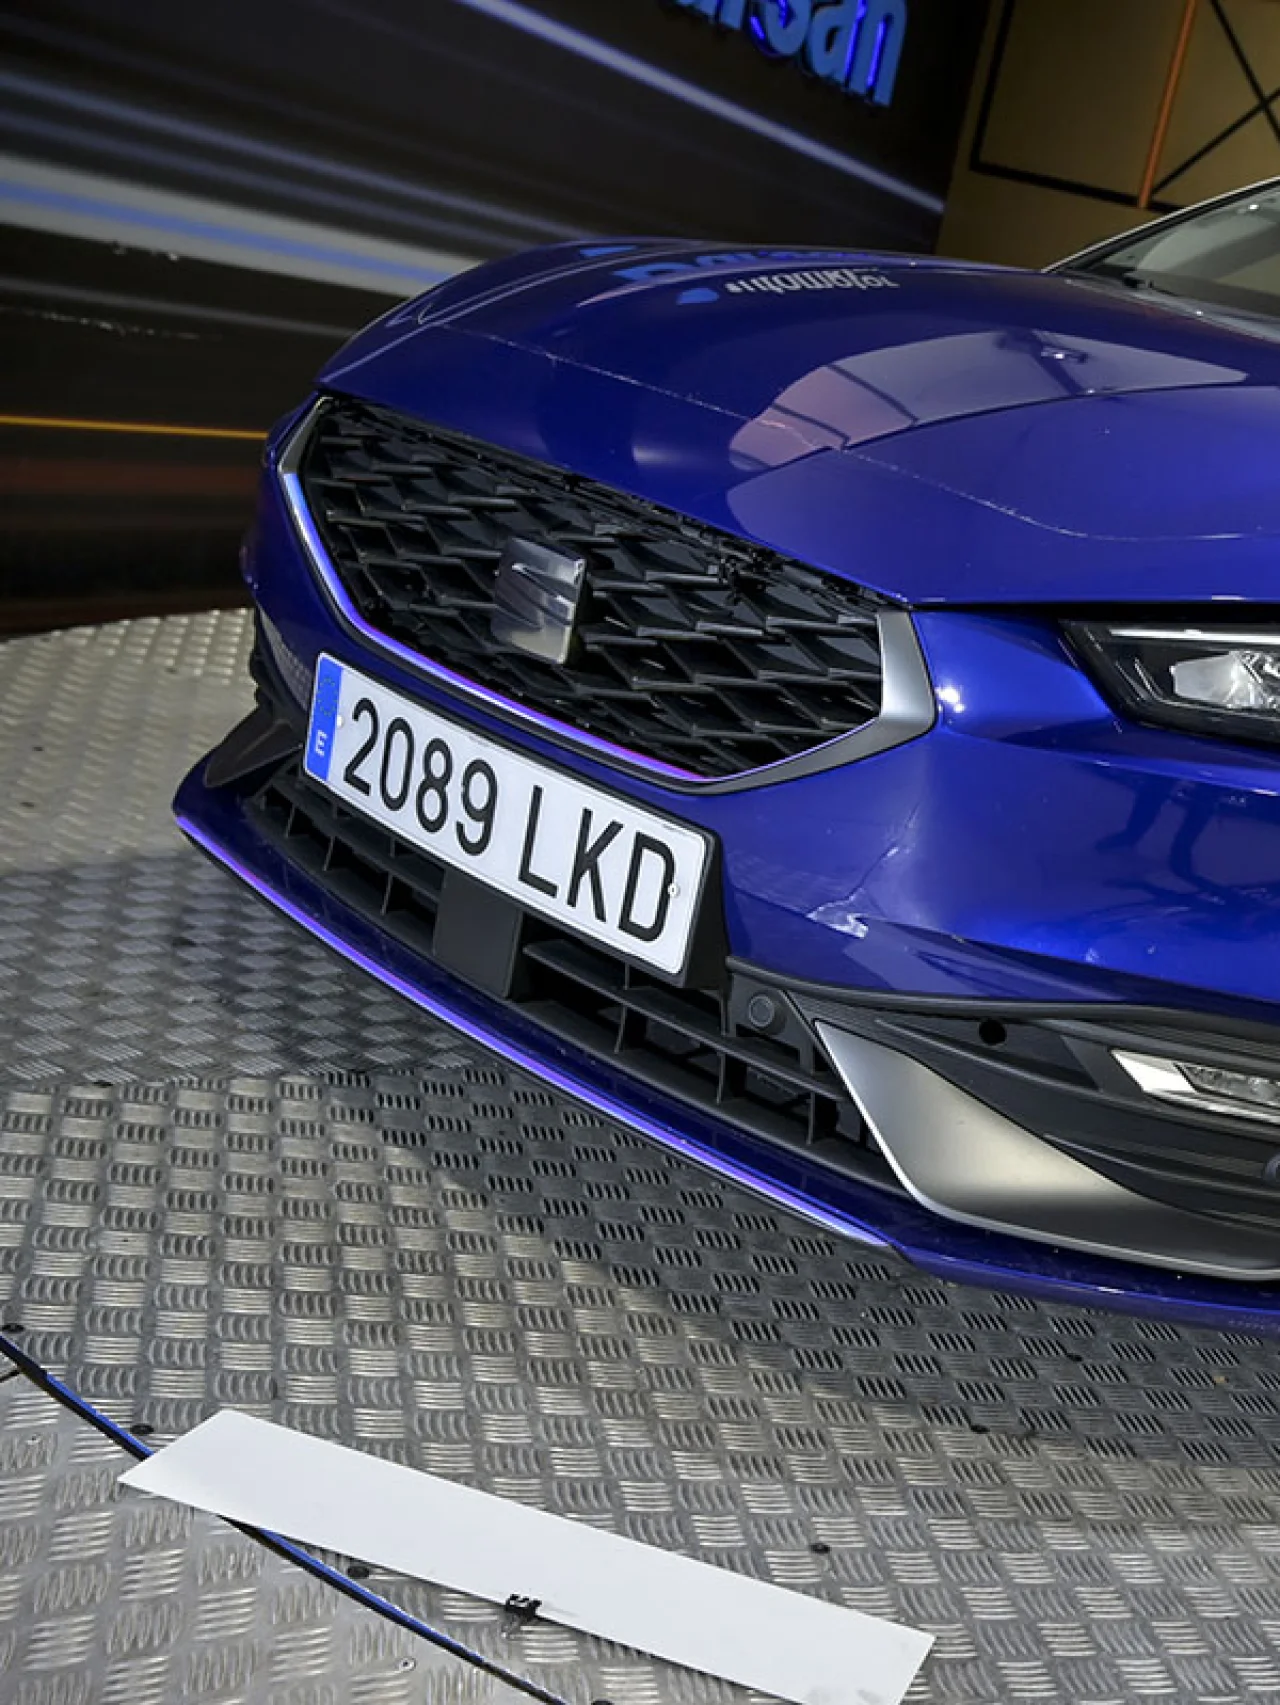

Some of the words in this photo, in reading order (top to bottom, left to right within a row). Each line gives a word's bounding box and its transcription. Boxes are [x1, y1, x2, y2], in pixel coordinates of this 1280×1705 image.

[315, 729, 328, 756] E
[343, 697, 498, 856] 2089
[518, 785, 676, 942] LKD
